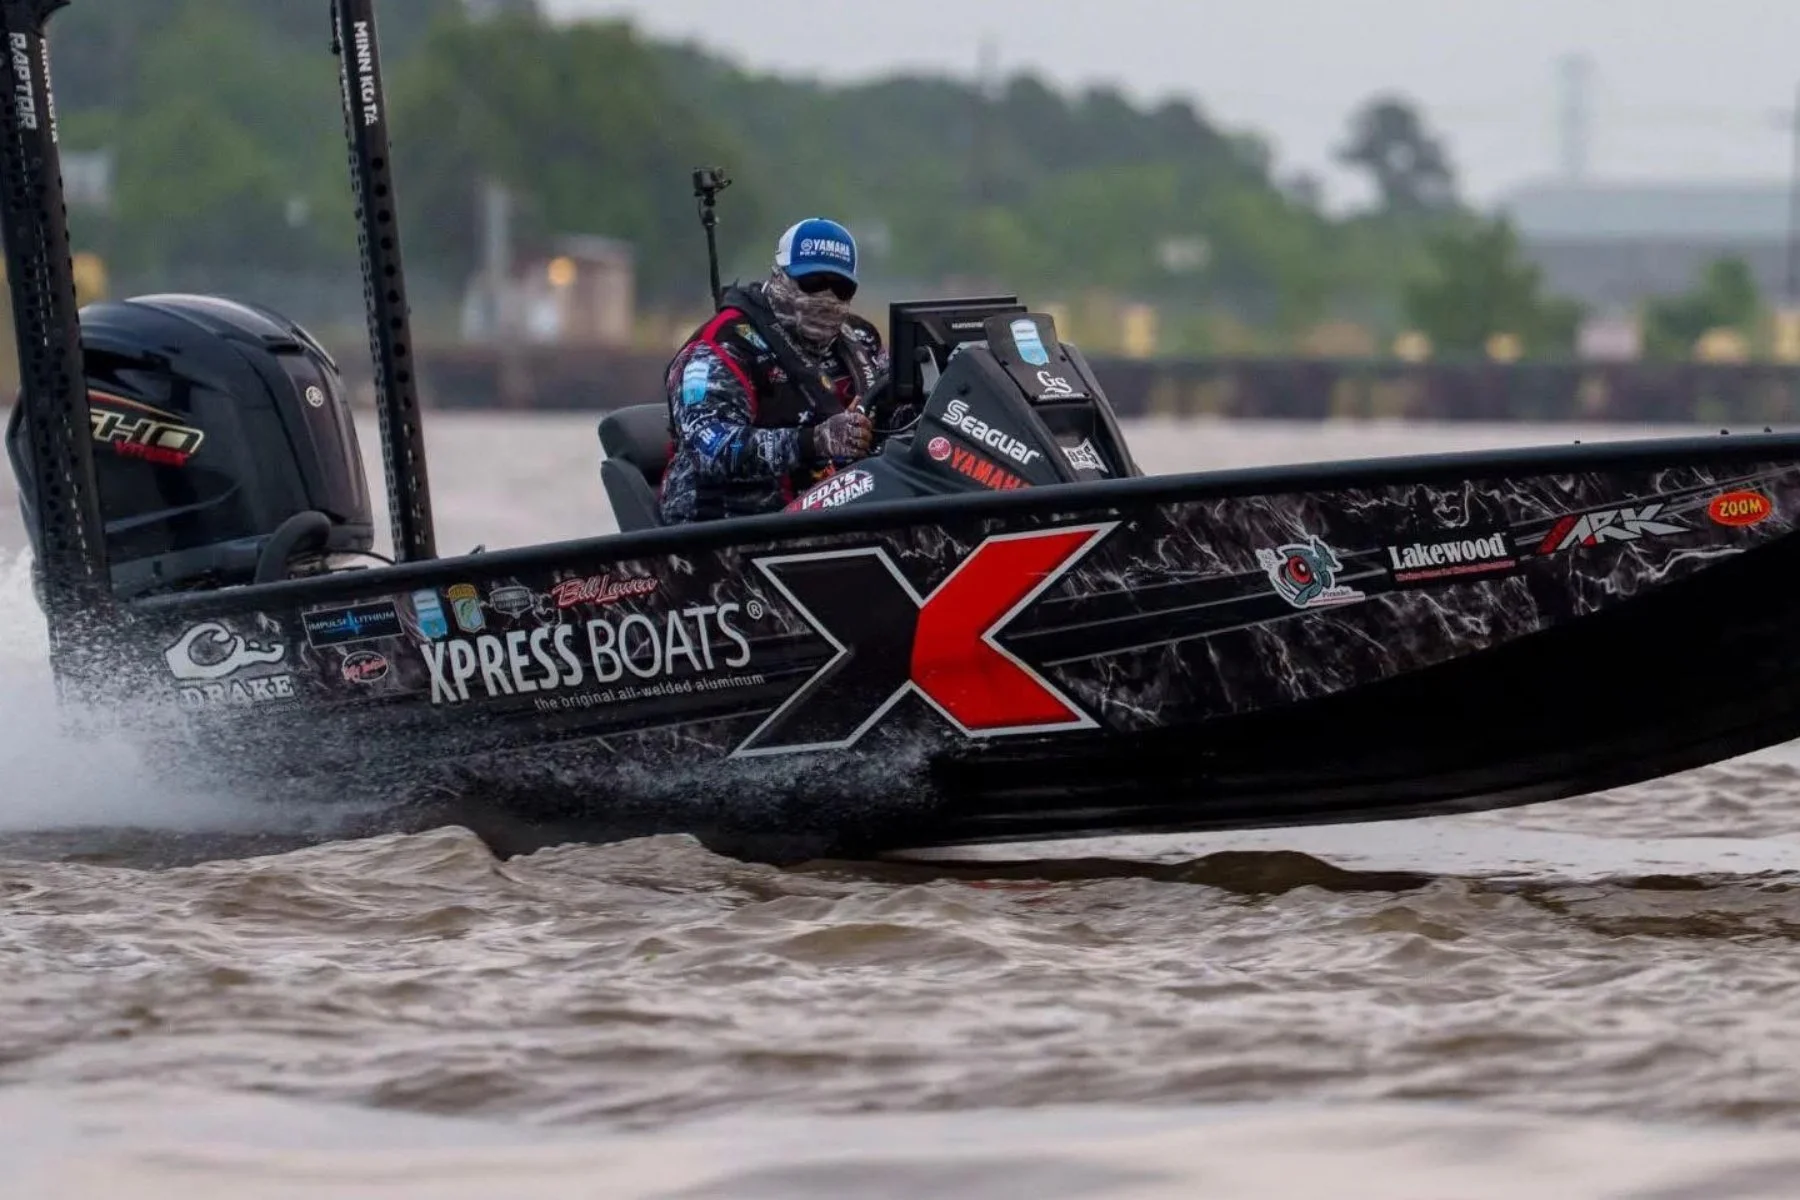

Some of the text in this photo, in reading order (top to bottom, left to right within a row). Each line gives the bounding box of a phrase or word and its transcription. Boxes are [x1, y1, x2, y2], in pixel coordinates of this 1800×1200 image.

[9, 32, 37, 130] RAPTOR
[353, 20, 378, 126] MINN KOTA
[813, 239, 851, 257] YAMAHA
[941, 400, 1040, 465] Seaguar
[951, 446, 1033, 491] YAMAH
[1542, 503, 1691, 551] ARK
[1719, 499, 1763, 517] ZOOM
[1388, 532, 1508, 570] Lakewood
[552, 575, 600, 606] Bill
[354, 611, 395, 624] LITHIUM
[420, 602, 751, 704] XPRESS BOATS
[180, 675, 295, 709] DRAKE
[534, 673, 765, 711] the original all-welded aluminum
